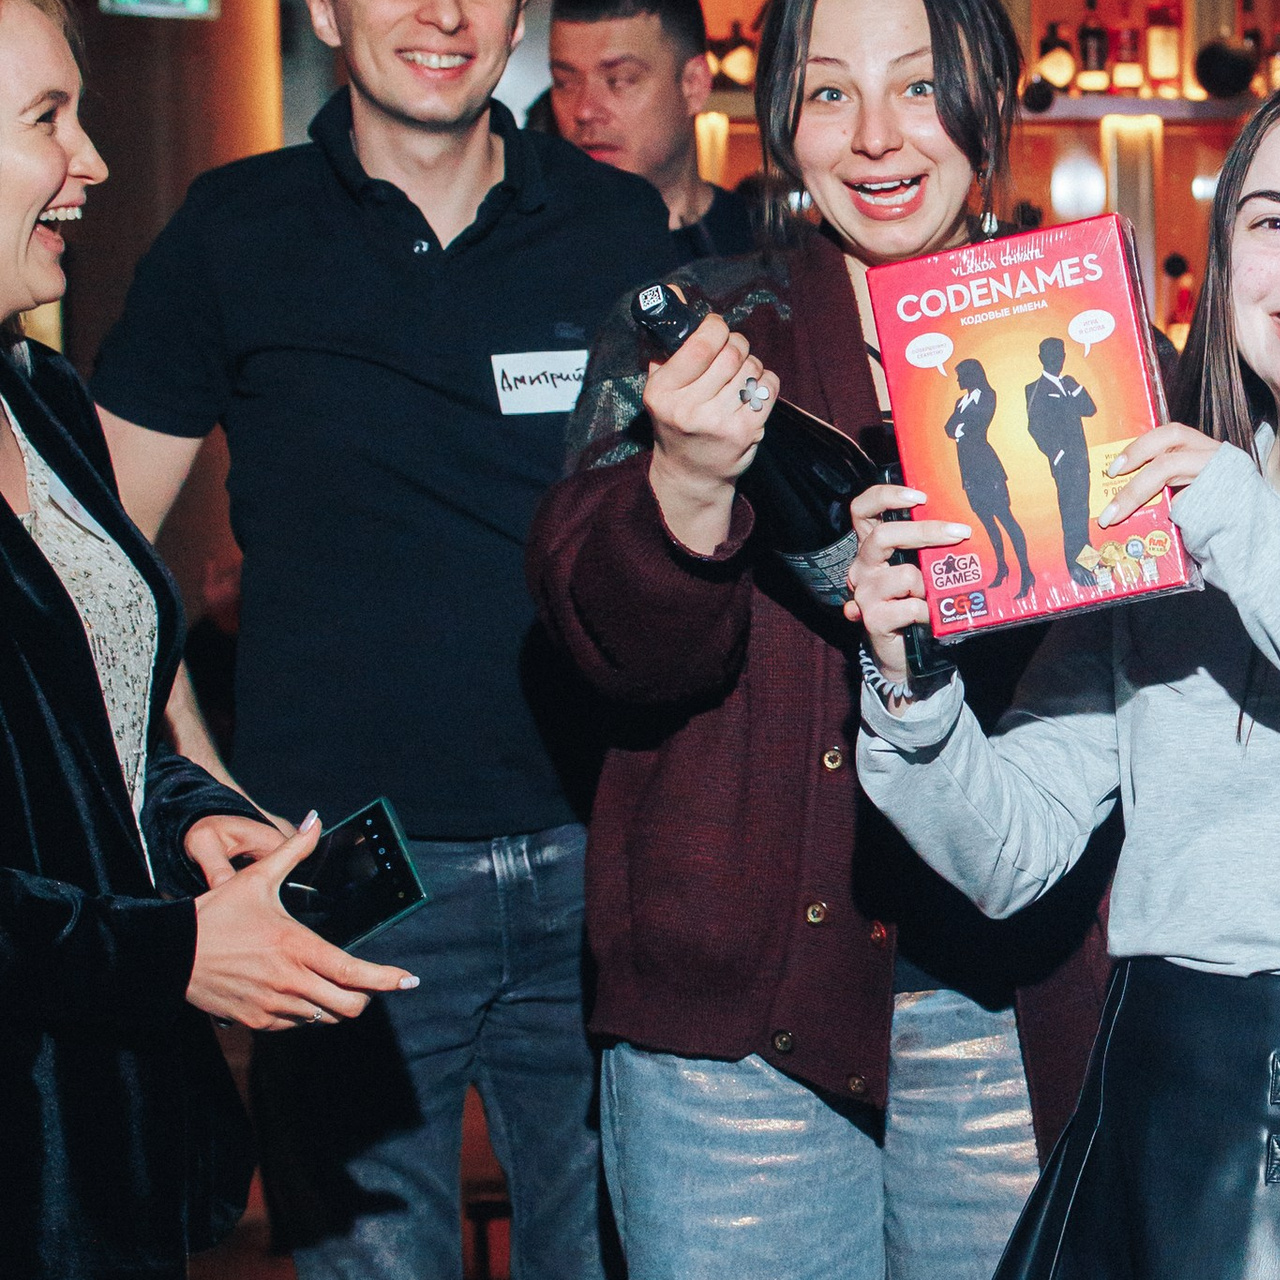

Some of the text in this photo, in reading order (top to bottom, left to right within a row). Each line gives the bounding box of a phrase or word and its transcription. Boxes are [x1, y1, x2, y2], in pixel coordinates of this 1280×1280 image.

[896, 253, 1104, 322] CODENAMES
[960, 299, 1048, 326] КОДОВЫЕ ИМЕНА
[935, 569, 981, 588] GAMES
